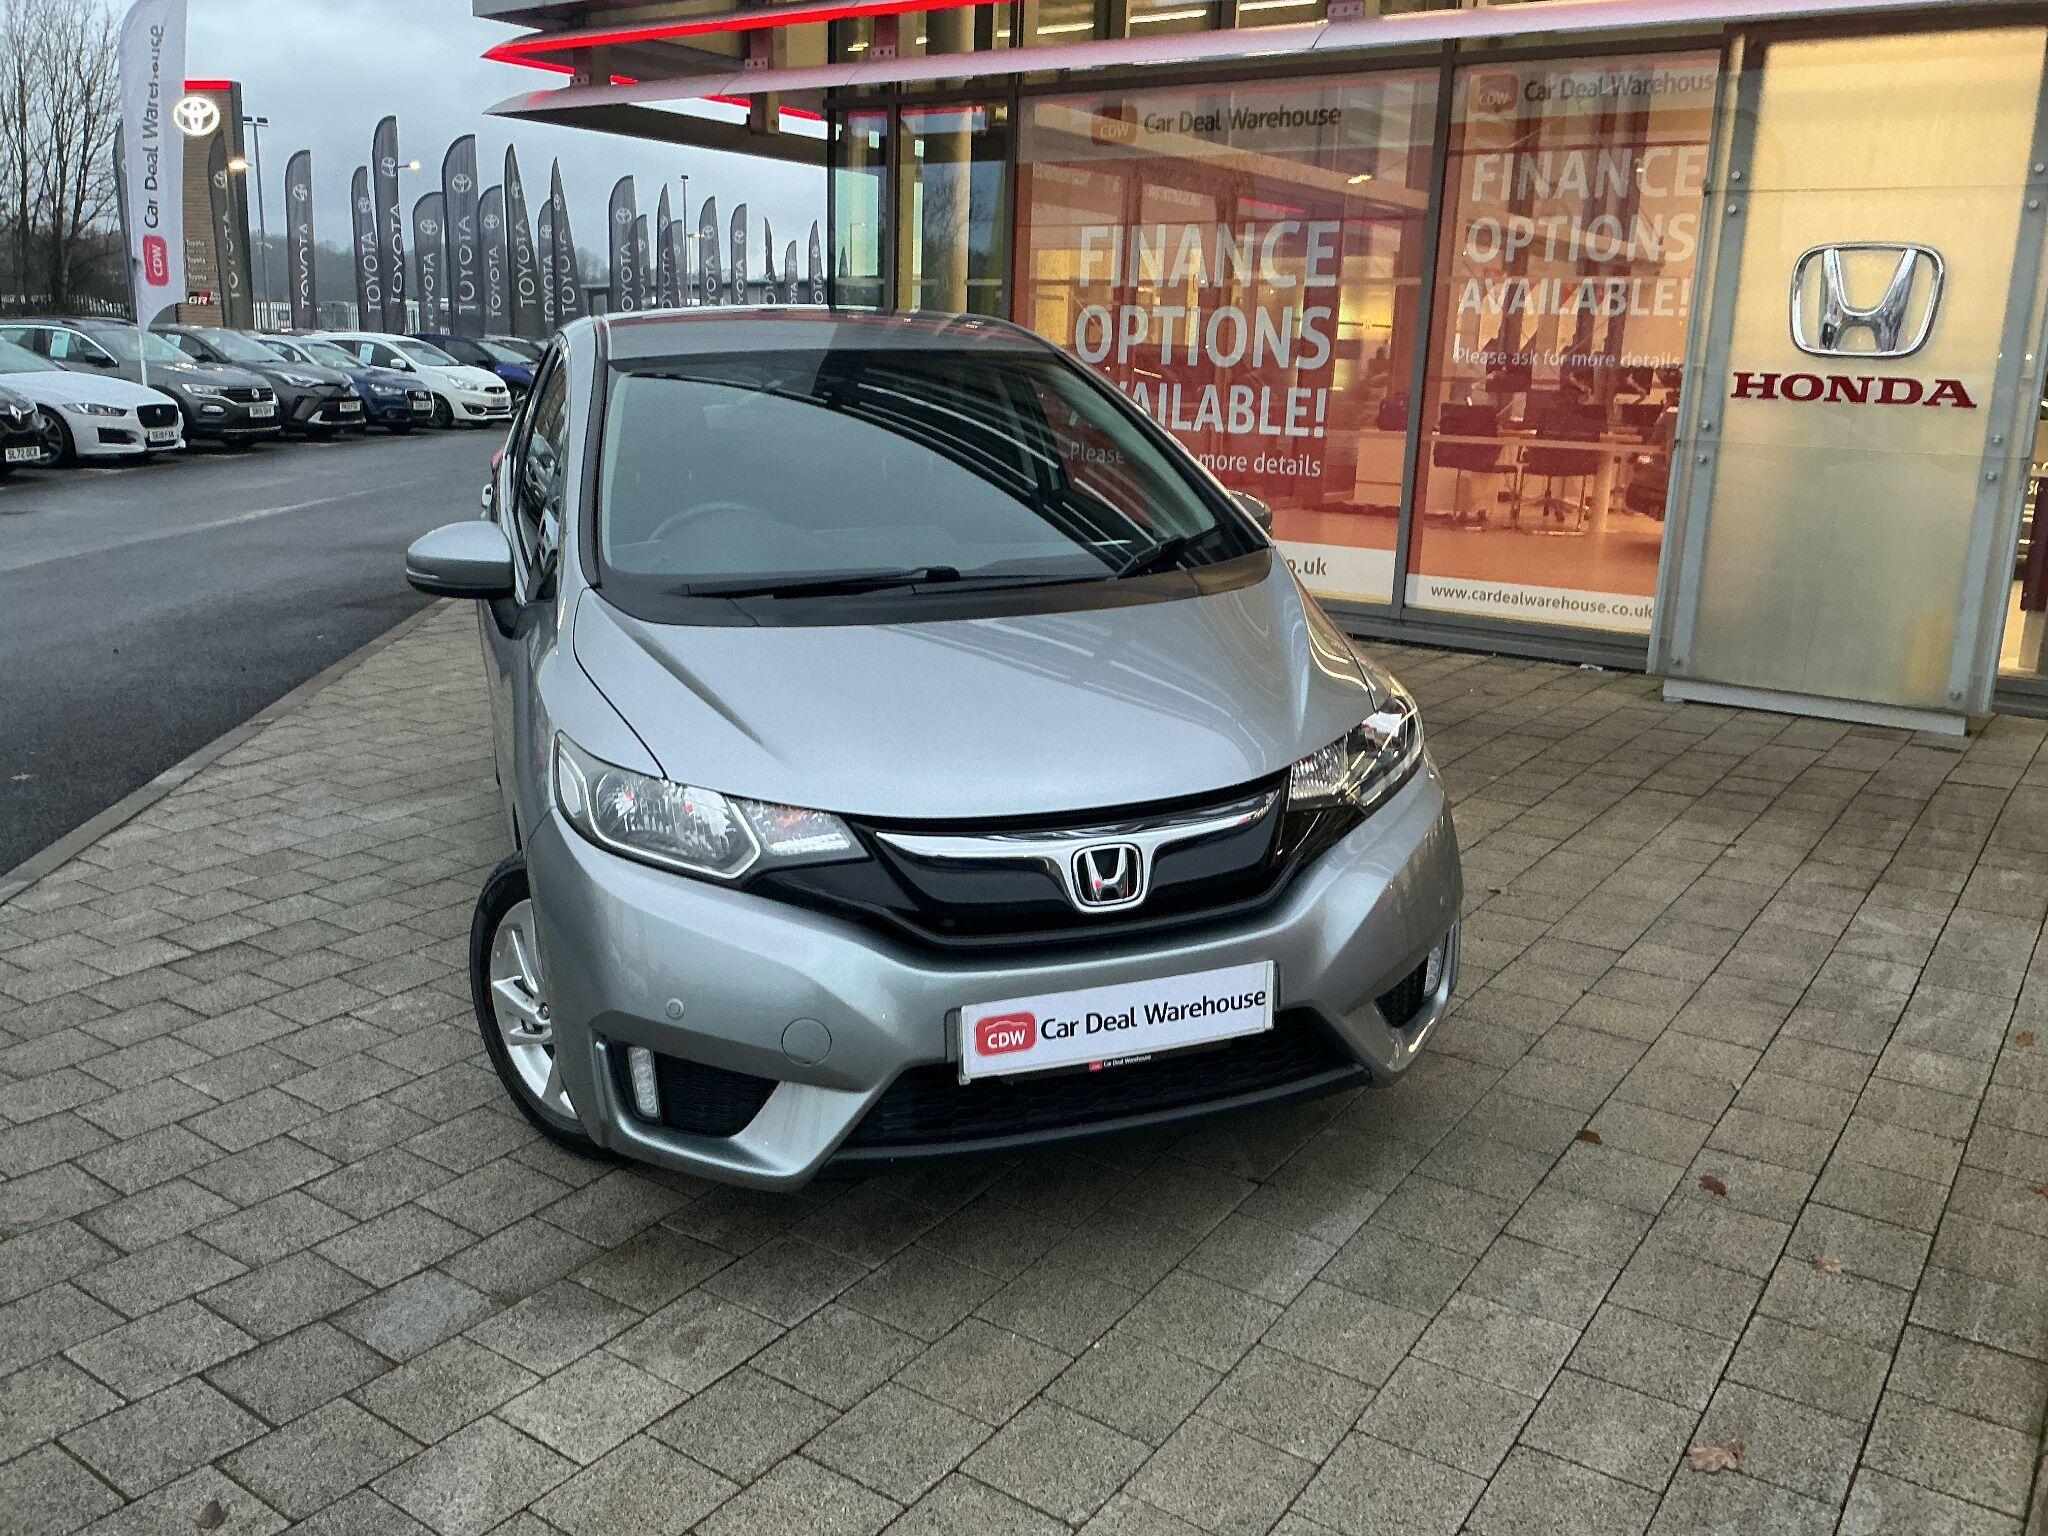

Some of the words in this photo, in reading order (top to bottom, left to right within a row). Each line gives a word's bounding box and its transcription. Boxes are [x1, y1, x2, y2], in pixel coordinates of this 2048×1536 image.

[1523, 80, 1555, 103] Car
[1560, 75, 1608, 100] Deal
[1610, 70, 1717, 97] Warehous
[1100, 123, 1129, 139] CDW
[1143, 113, 1174, 135] Car
[1179, 108, 1222, 133] Deal
[1228, 104, 1342, 131] Warehouse
[143, 145, 159, 191] Deal
[1471, 146, 1709, 201] FINANCE
[144, 198, 159, 229] Car
[1466, 212, 1698, 263] OPTIONS
[151, 244, 163, 277] CDW
[361, 231, 381, 313] TOYOTA
[389, 202, 402, 305] TOYOTA
[458, 215, 476, 315] TOYOTA
[516, 219, 537, 308] TOYOTA
[621, 242, 634, 312] OYOTA
[1079, 220, 1341, 288] FINANCE
[488, 245, 502, 318] TOYOTA
[1456, 277, 1691, 317] AVAILABLE!
[1076, 304, 1332, 370] OPTIONS
[1454, 349, 1507, 365] Please
[1511, 348, 1538, 365] ask
[1543, 349, 1566, 366] for
[1571, 353, 1616, 367] more
[1620, 349, 1682, 369] details
[1730, 371, 1978, 409] HONDA
[1070, 441, 1125, 465] Please
[1199, 451, 1247, 472] more
[1253, 451, 1322, 477] details
[1431, 585, 1653, 619] www.cardealwarehouse.co.uk
[986, 1029, 1026, 1050] CDW
[1040, 1017, 1080, 1040] Car
[1085, 1006, 1138, 1035] Deal
[1143, 990, 1267, 1025] Warehouse
